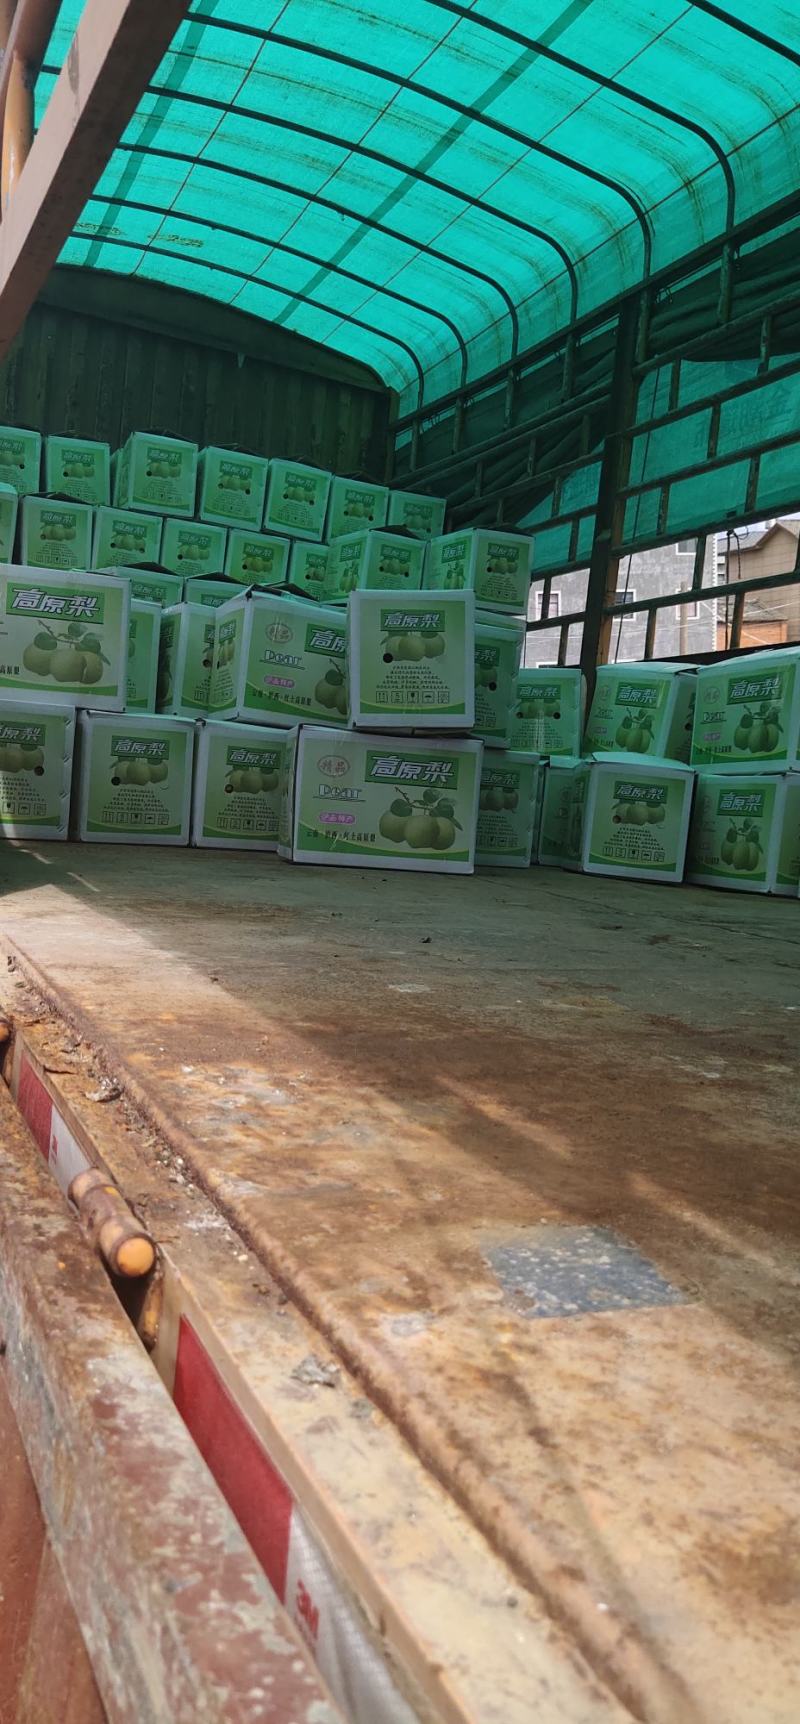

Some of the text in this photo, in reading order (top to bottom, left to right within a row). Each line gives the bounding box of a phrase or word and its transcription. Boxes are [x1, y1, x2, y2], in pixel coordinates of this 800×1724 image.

[11, 588, 101, 617] 高原梨
[384, 612, 441, 628] 高原梨
[618, 685, 657, 704] 高原梨
[730, 677, 780, 699] 高原梨
[0, 726, 42, 742] 原梨
[114, 739, 166, 757] 高原梨
[229, 748, 277, 765] 高原梨
[369, 755, 455, 783] 高原梨
[616, 783, 665, 800] 高原梨
[719, 792, 762, 812] 高原梨
